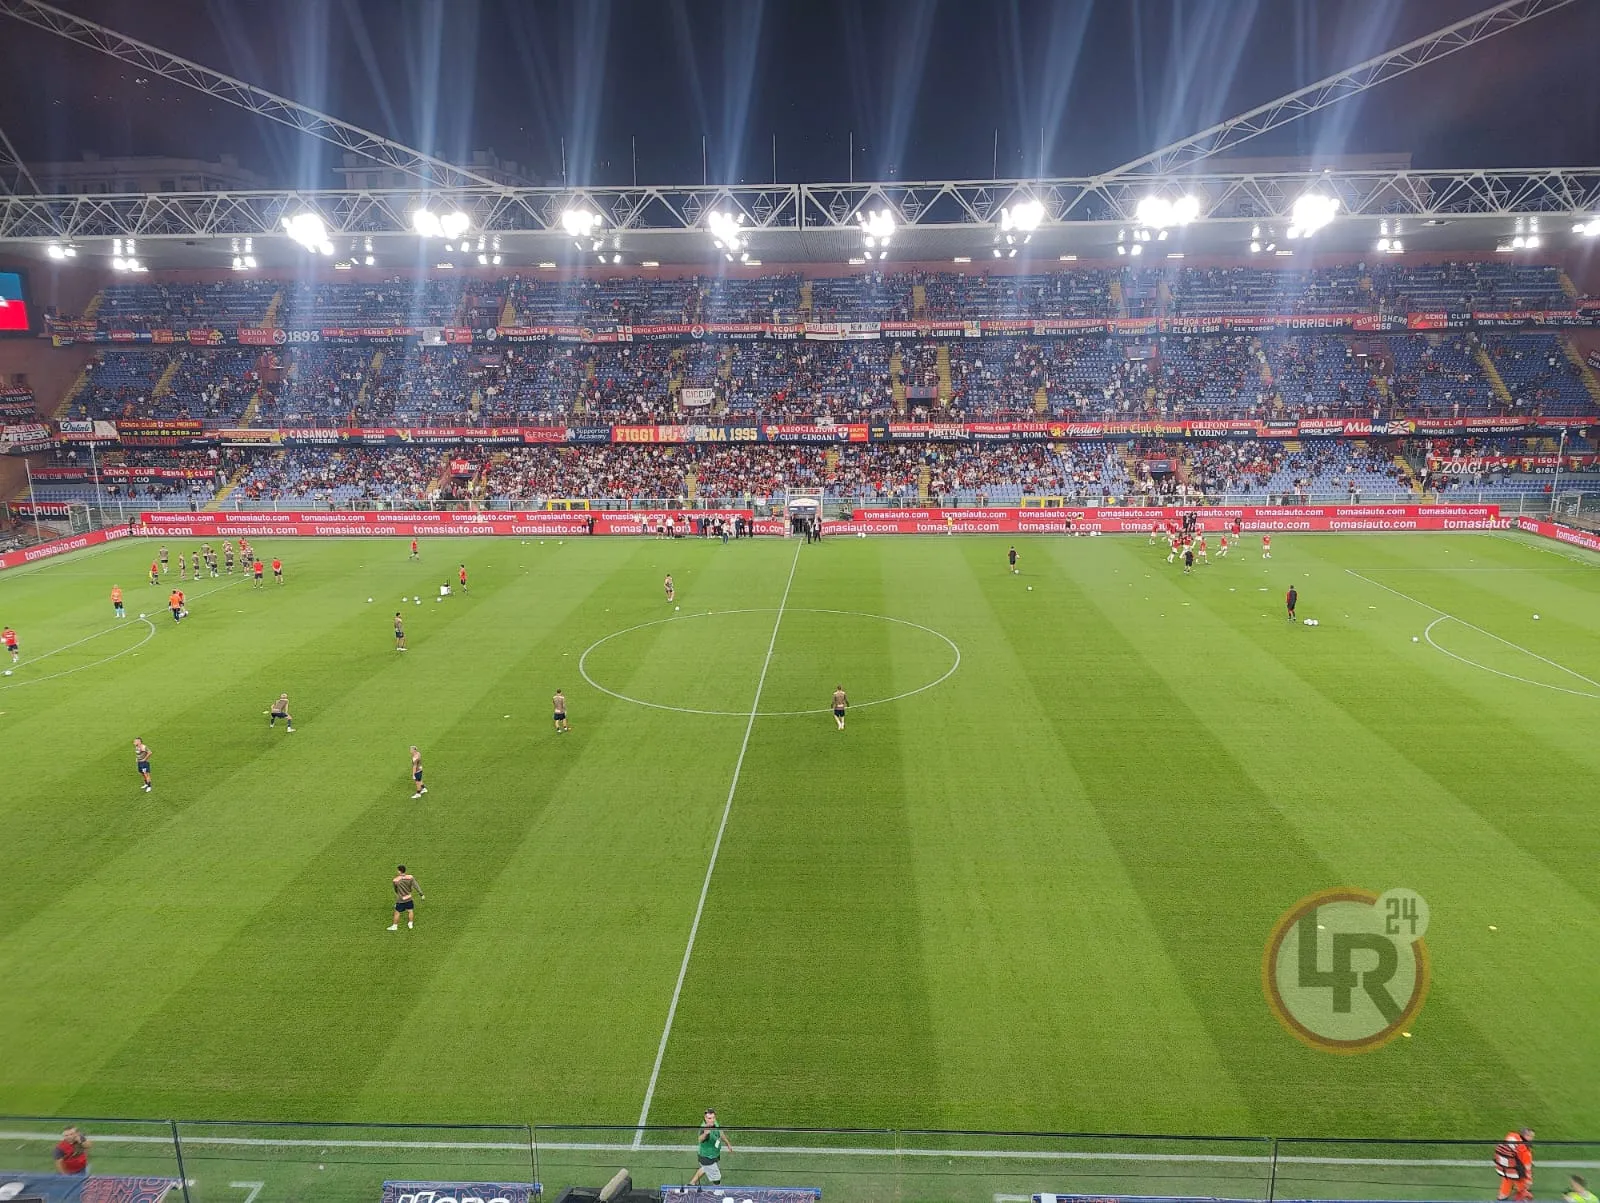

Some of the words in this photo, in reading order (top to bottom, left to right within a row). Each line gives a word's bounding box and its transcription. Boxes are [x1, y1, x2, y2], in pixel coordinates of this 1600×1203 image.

[1284, 317, 1343, 329] TORRIGLIA
[287, 329, 320, 343] 1893
[885, 330, 917, 338] REGIONE
[931, 329, 961, 337] LIGURIA
[1011, 423, 1048, 431] ZENEIXI
[1129, 423, 1152, 434] Club
[1152, 423, 1182, 434] Genoa
[1191, 421, 1229, 429] GRIFONI
[1343, 422, 1389, 433] Miami
[289, 429, 340, 440] CASANOVA
[576, 428, 610, 436] Supporters
[615, 428, 655, 442] FIGGI
[729, 427, 758, 441] 1995
[1022, 431, 1047, 439] ROMA
[1193, 429, 1228, 437] TORINO
[864, 511, 929, 519] tomasiauto.com
[941, 511, 1007, 519] tomasiauto.com
[1336, 507, 1406, 515] tomasiauto.com
[1418, 506, 1488, 515] tomasiauto.com
[150, 514, 215, 522] tomasiauto.com
[225, 514, 290, 522] tomasiauto.com
[301, 514, 365, 522] tomasiauto.com
[376, 514, 441, 522] tomasiauto.com
[916, 522, 1000, 532] tomasauto.com
[1017, 521, 1102, 530] tomasiauo.com
[1329, 519, 1417, 529] tomasiauto.com
[216, 525, 298, 535] tomasiauto.com
[315, 525, 396, 535] tomasiauto.com
[412, 524, 494, 534] tomasiauto.com
[24, 537, 88, 561] tomasiauto.com
